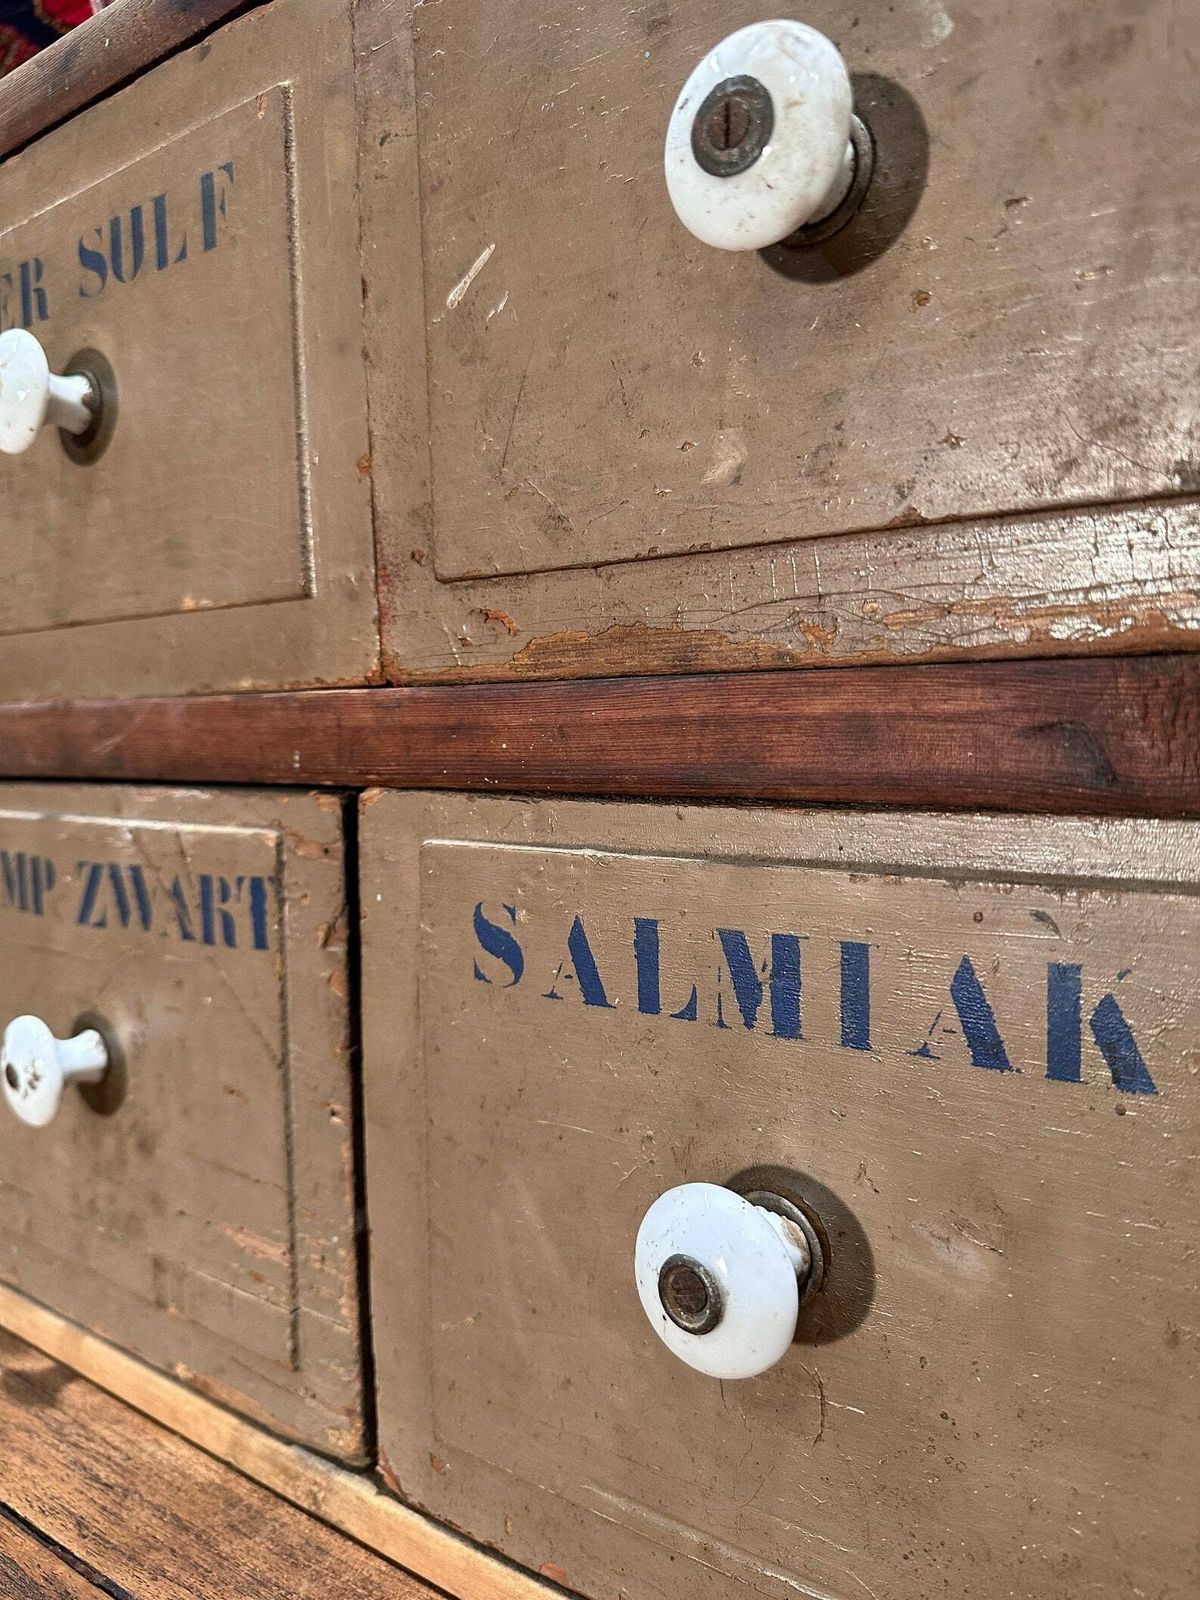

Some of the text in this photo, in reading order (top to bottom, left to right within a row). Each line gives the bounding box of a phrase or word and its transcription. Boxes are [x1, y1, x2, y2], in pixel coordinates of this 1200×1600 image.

[78, 160, 234, 298] SULF
[76, 860, 276, 950] ZWART
[472, 901, 1158, 1094] SALMIAK
